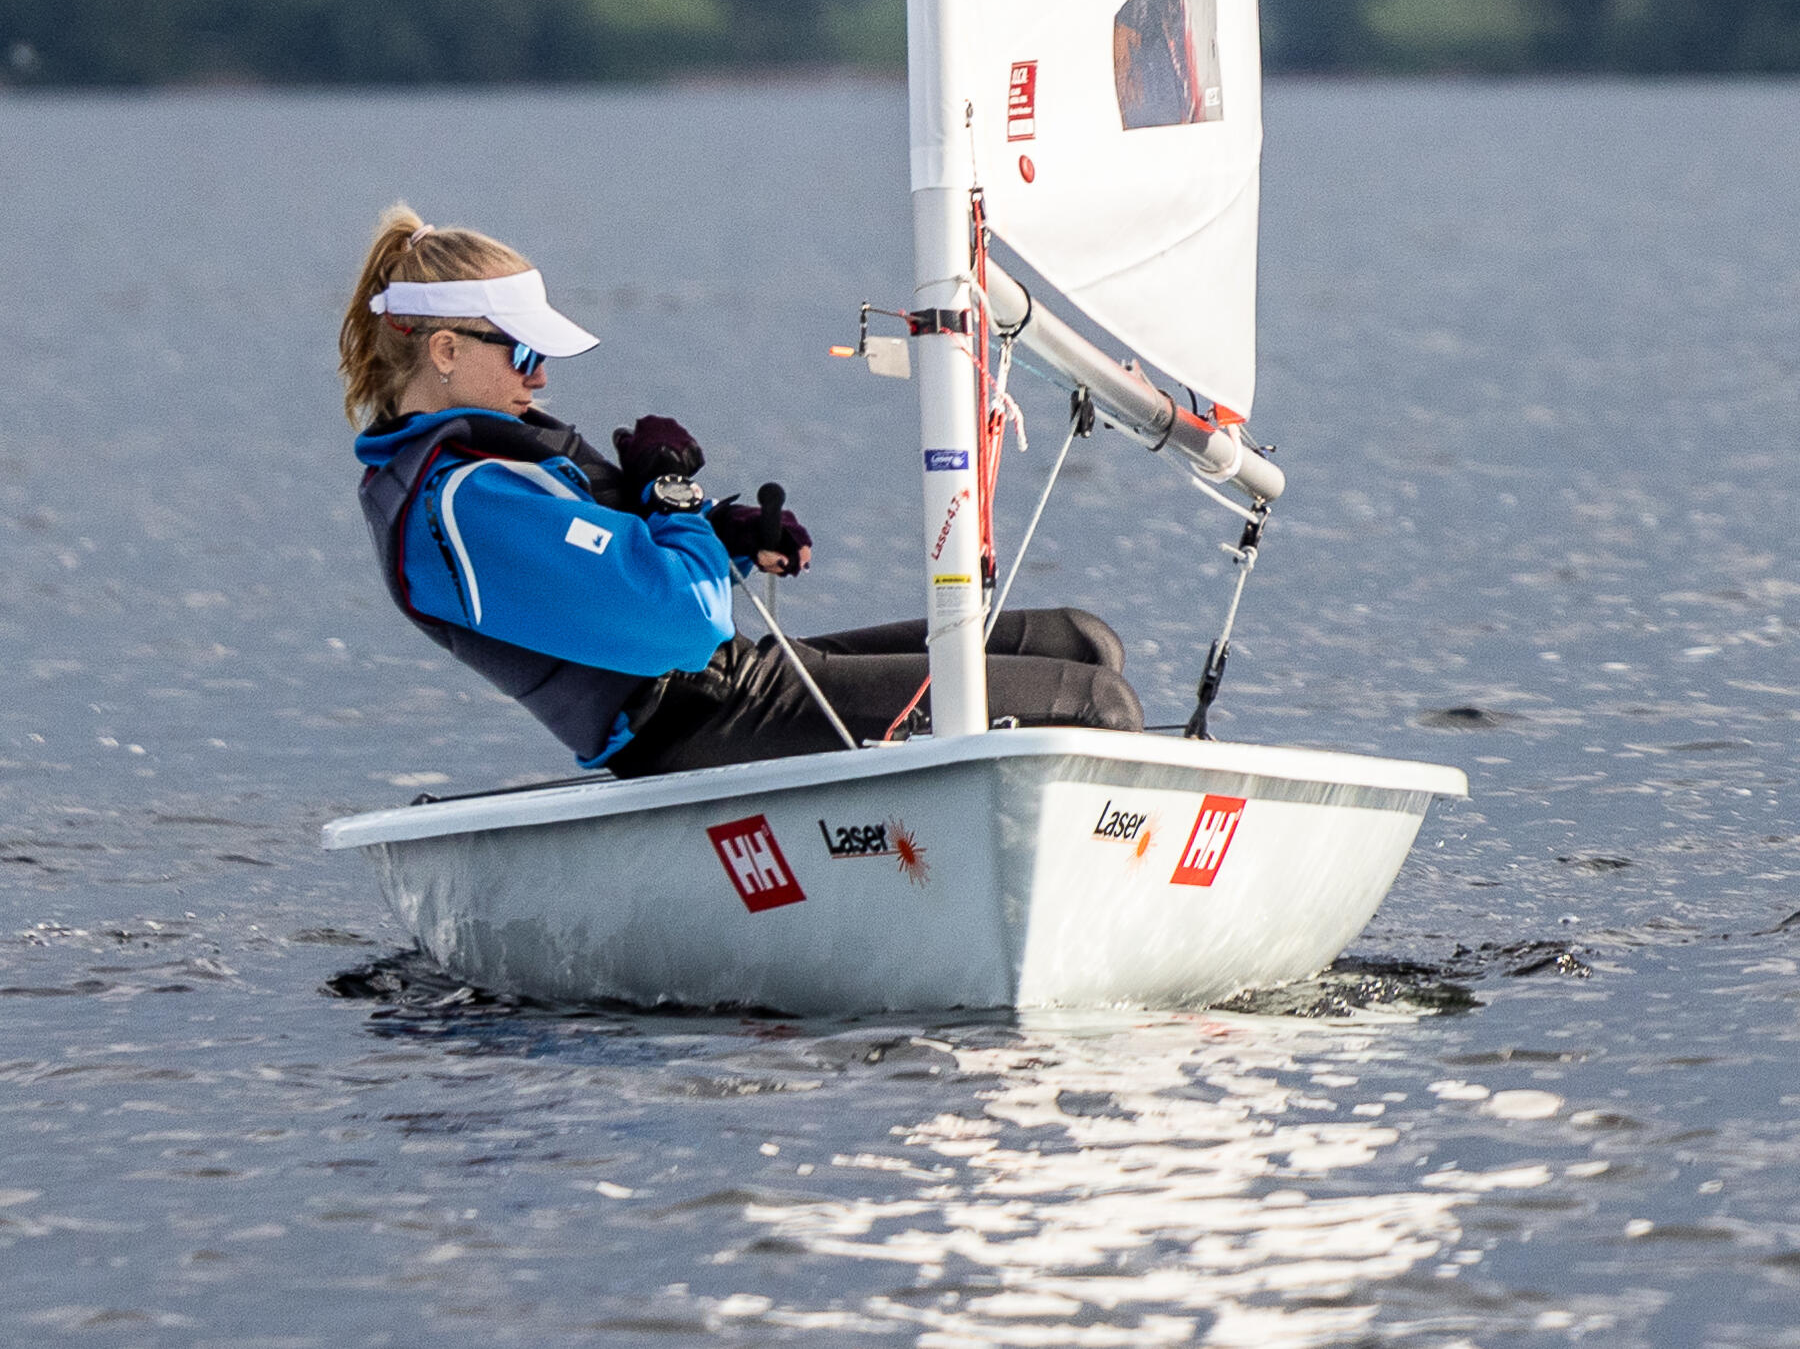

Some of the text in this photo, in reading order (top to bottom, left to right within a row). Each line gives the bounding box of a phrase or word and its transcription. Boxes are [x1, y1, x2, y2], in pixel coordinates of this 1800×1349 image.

[931, 519, 952, 561] Laser
[817, 819, 888, 855] Laser
[1093, 799, 1147, 840] Laser
[1182, 808, 1237, 871] HH
[720, 831, 789, 895] HH
